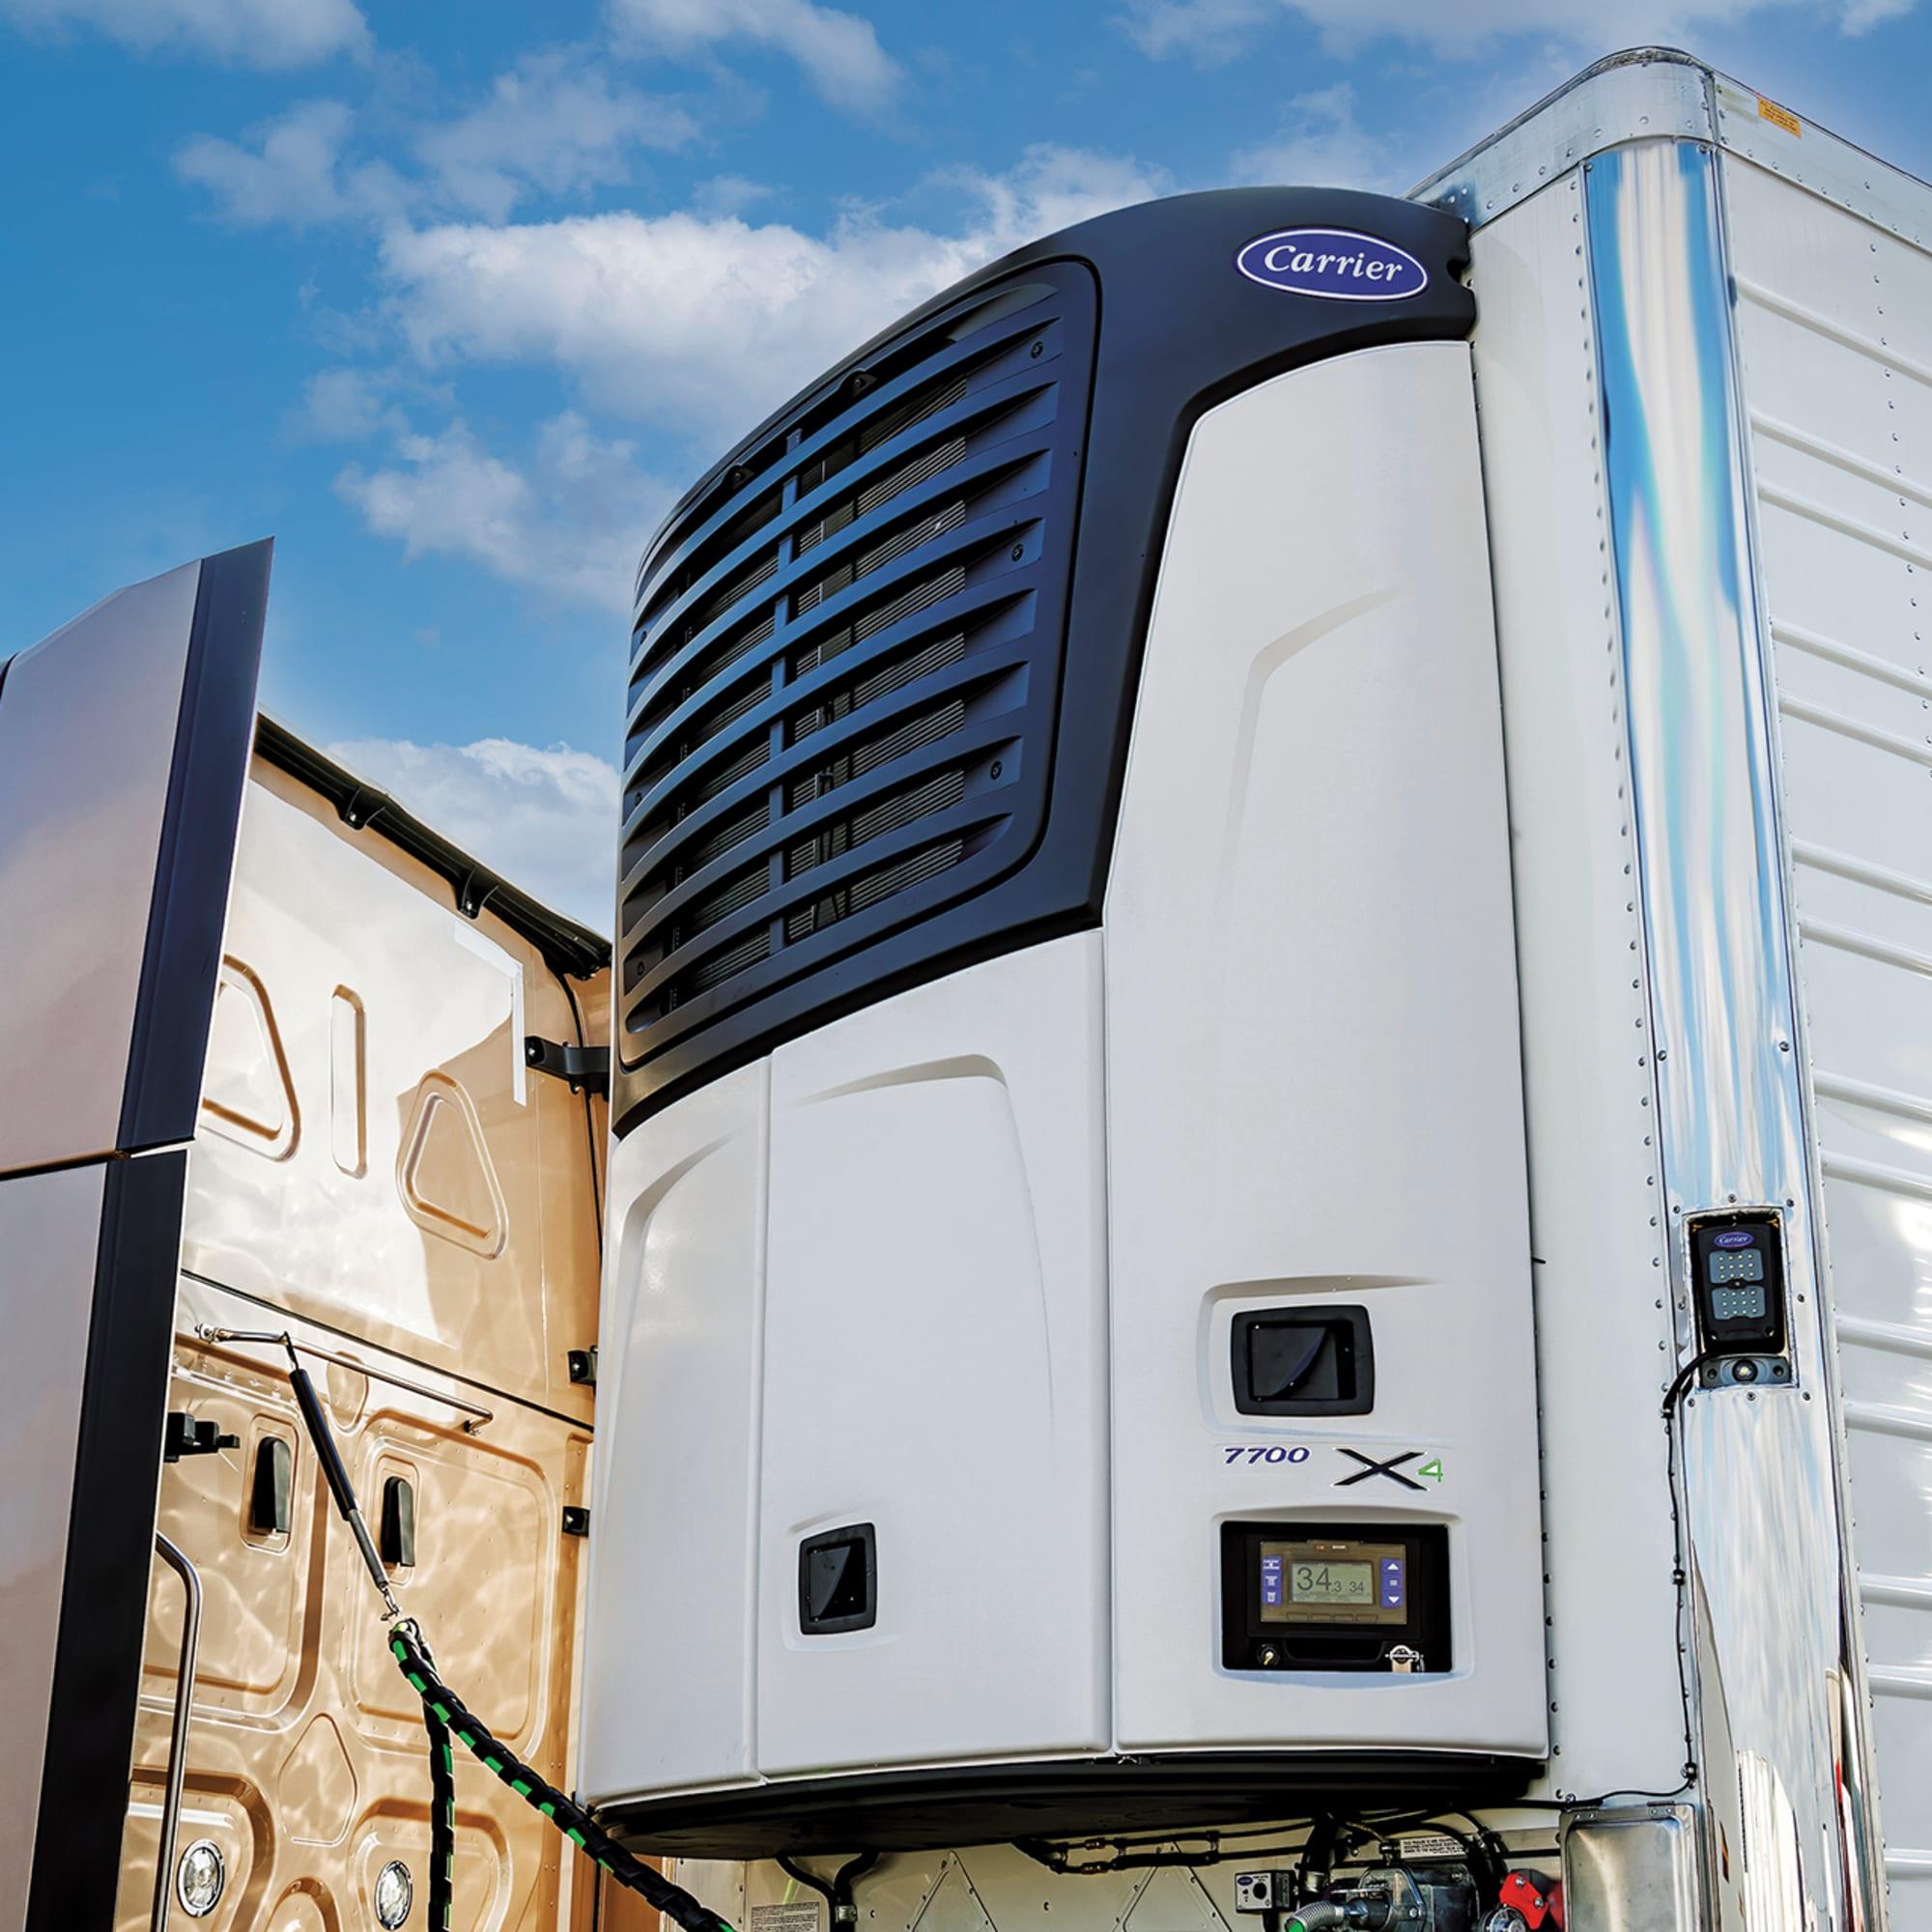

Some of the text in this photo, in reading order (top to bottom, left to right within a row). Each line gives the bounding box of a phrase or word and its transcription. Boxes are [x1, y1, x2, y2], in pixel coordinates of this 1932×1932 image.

[1264, 244, 1404, 282] Carrier
[1224, 1447, 1310, 1464] 7700
[1350, 1580, 1364, 1593] 34
